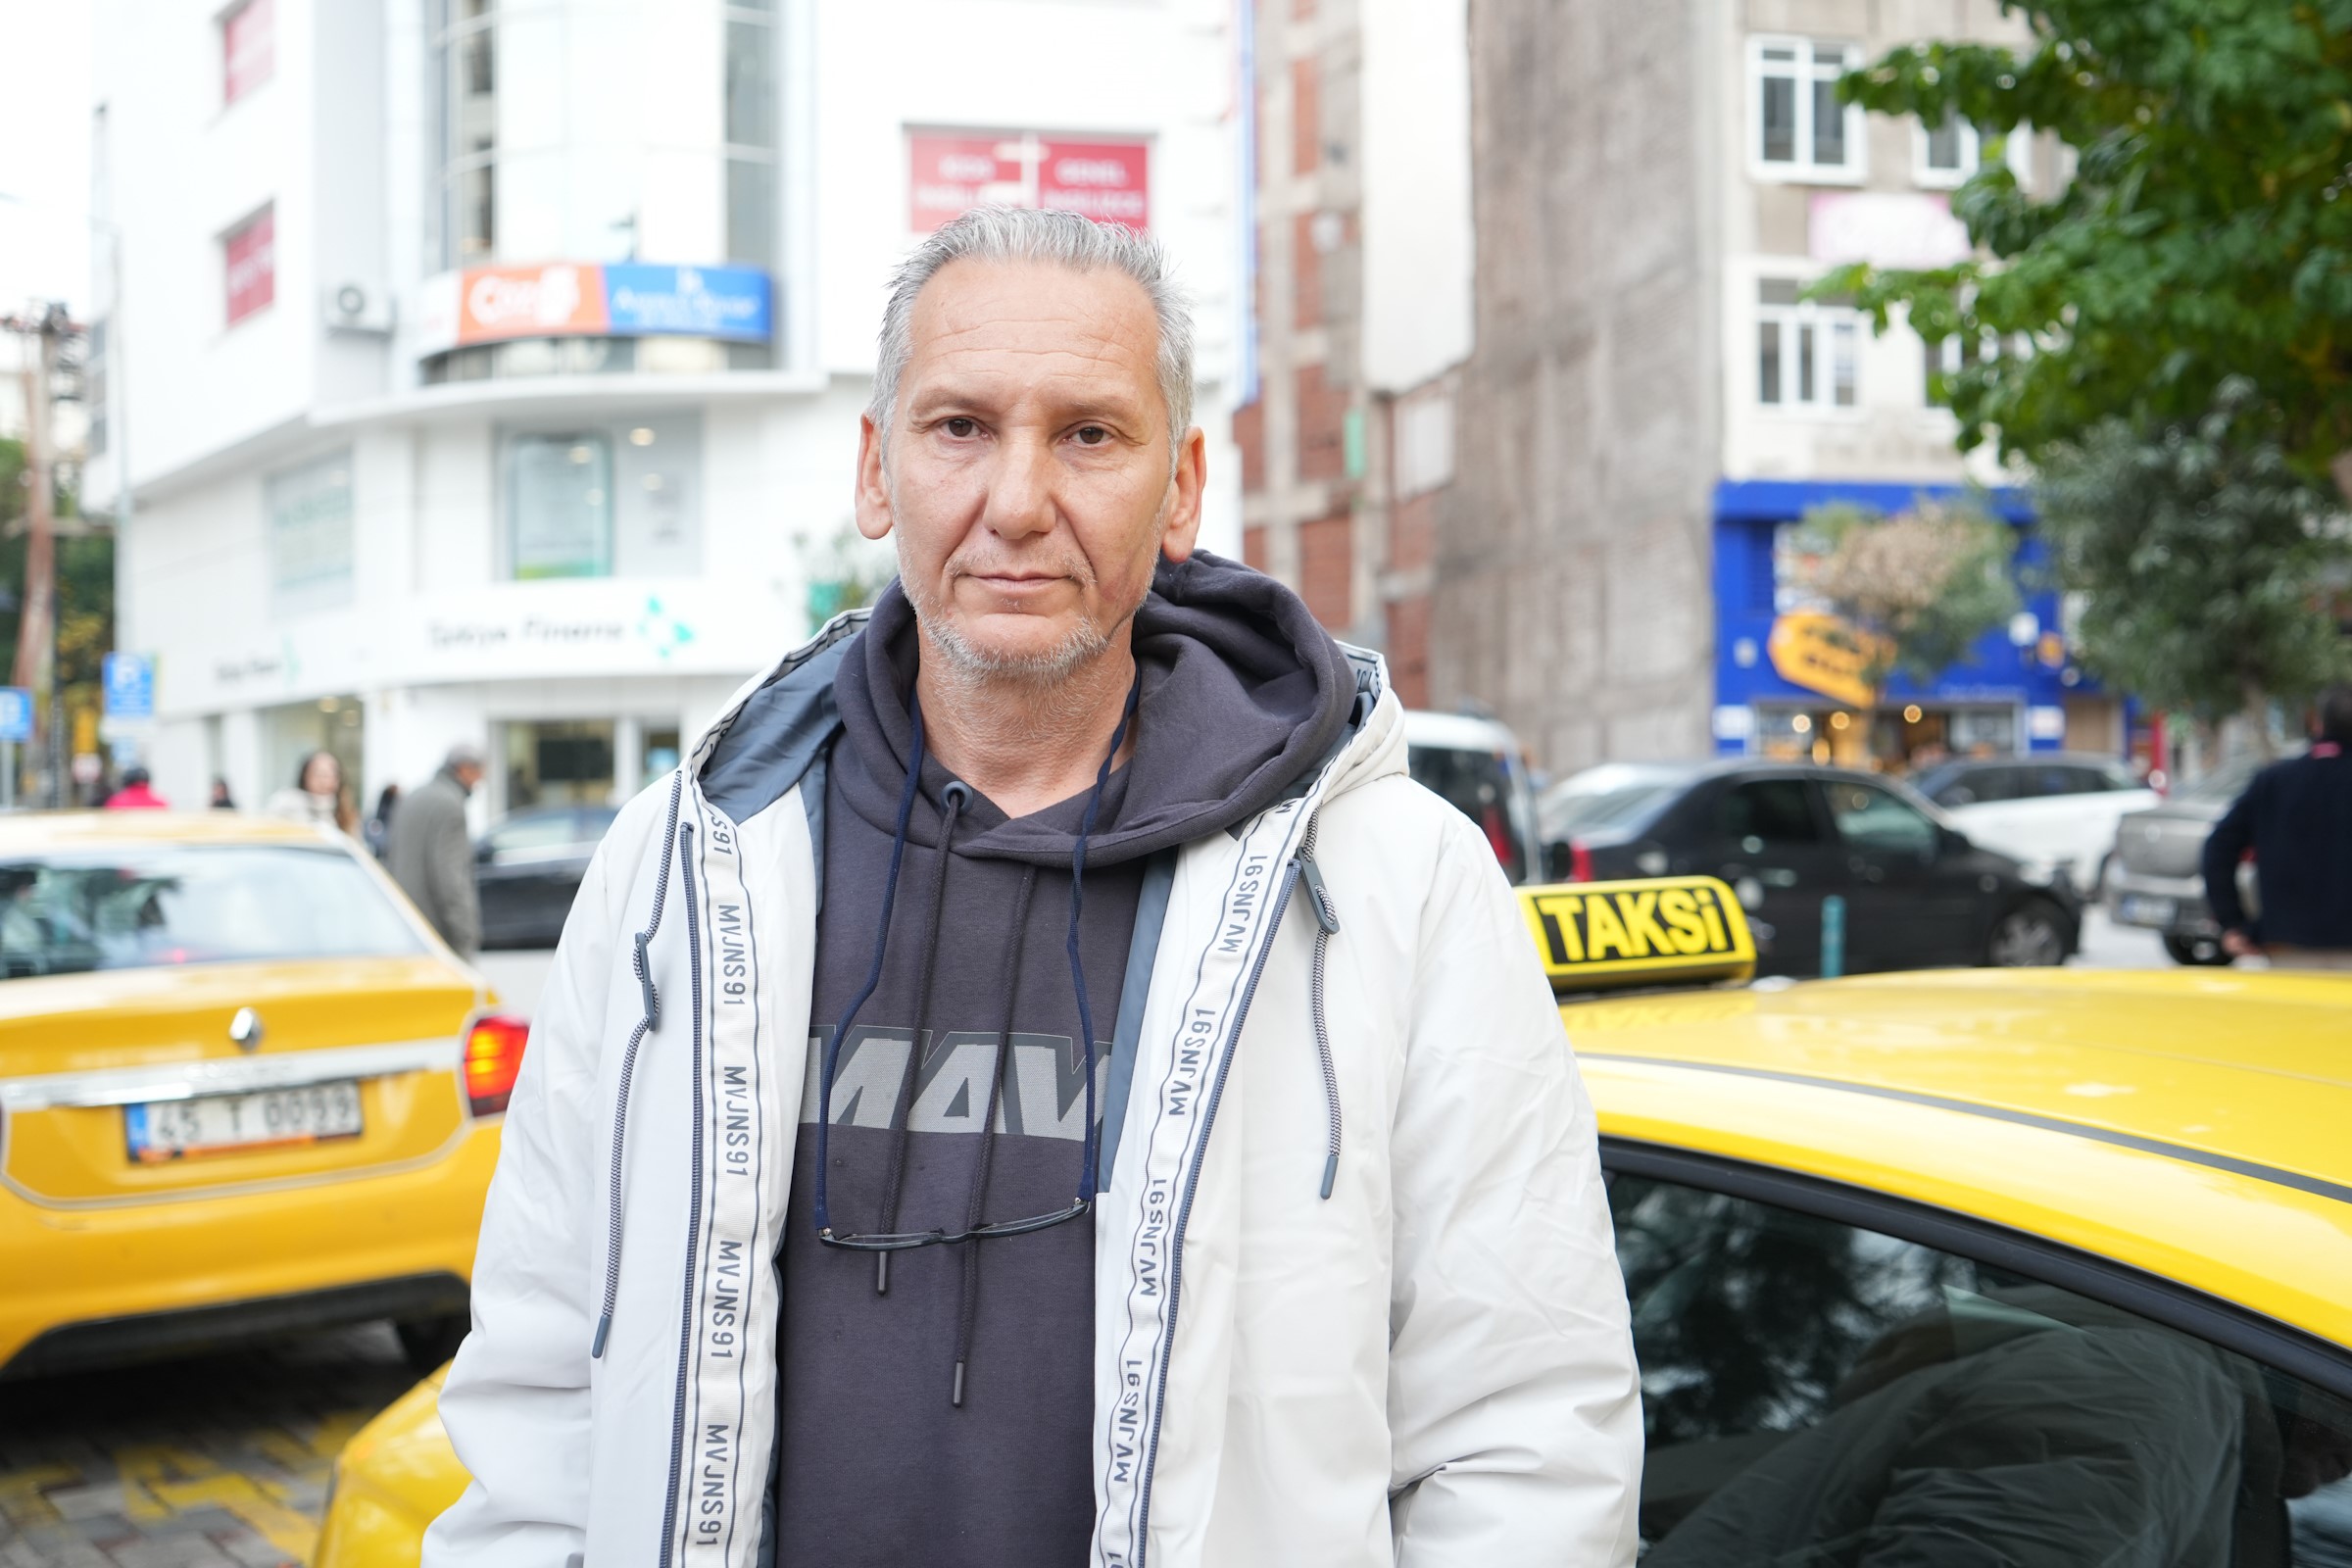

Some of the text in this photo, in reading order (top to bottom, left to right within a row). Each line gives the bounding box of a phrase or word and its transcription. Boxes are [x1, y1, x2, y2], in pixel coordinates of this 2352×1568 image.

[718, 905, 747, 1004] MVJNS91
[1218, 855, 1269, 953] MVJNS91
[1168, 1007, 1216, 1115] MVJNS91
[723, 1065, 750, 1178] MVJNS91
[1139, 1178, 1167, 1297] MVJNS91
[710, 1240, 743, 1358] MVJNS91
[1113, 1359, 1143, 1483] MVJNS91
[696, 1424, 729, 1545] MVJNS91
